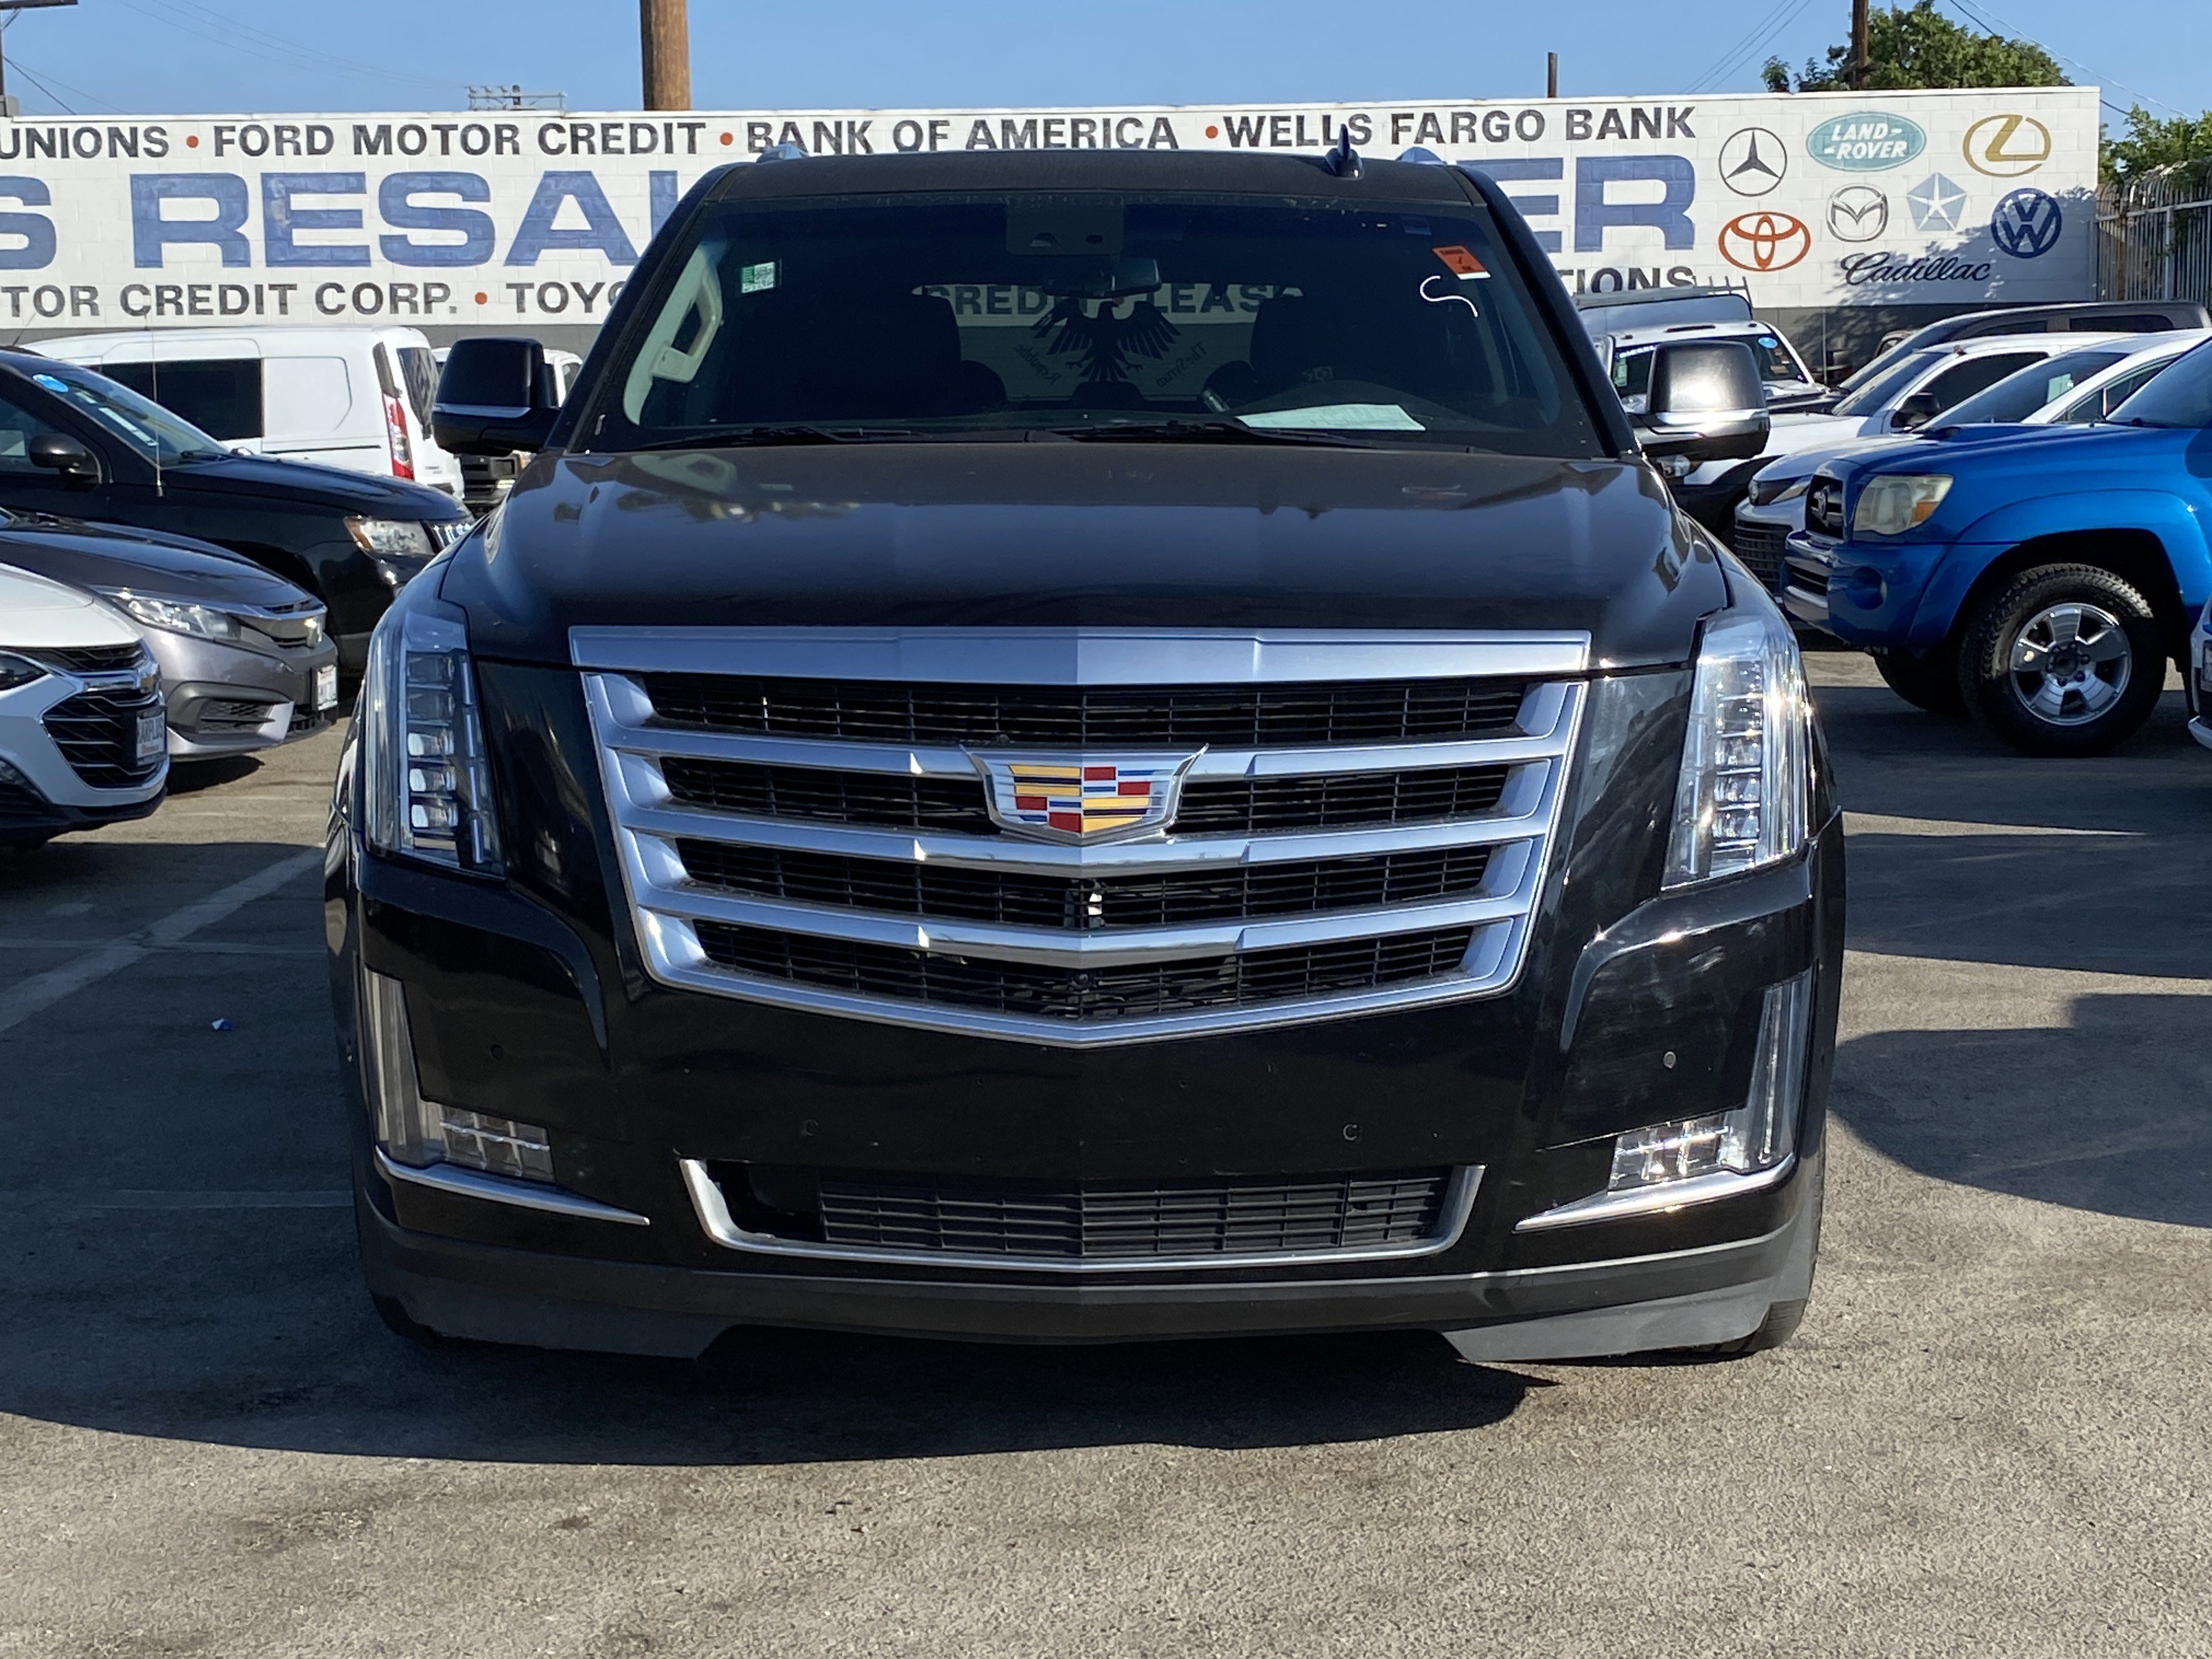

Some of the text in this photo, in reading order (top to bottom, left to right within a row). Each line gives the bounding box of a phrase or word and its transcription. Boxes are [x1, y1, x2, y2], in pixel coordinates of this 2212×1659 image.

[213, 124, 335, 157] FORD
[353, 123, 520, 156] MOTOR
[538, 122, 706, 155] CREDIT
[747, 120, 874, 155] BANK
[893, 120, 950, 153] OF
[966, 117, 1179, 150] AMERICA
[1222, 113, 1372, 148] WELLS
[1391, 109, 1545, 145] FARGO
[1565, 106, 1696, 141] BANK
[1841, 251, 1991, 286] Cadillac
[120, 283, 297, 317] CREDIT
[315, 282, 458, 315] CORP.
